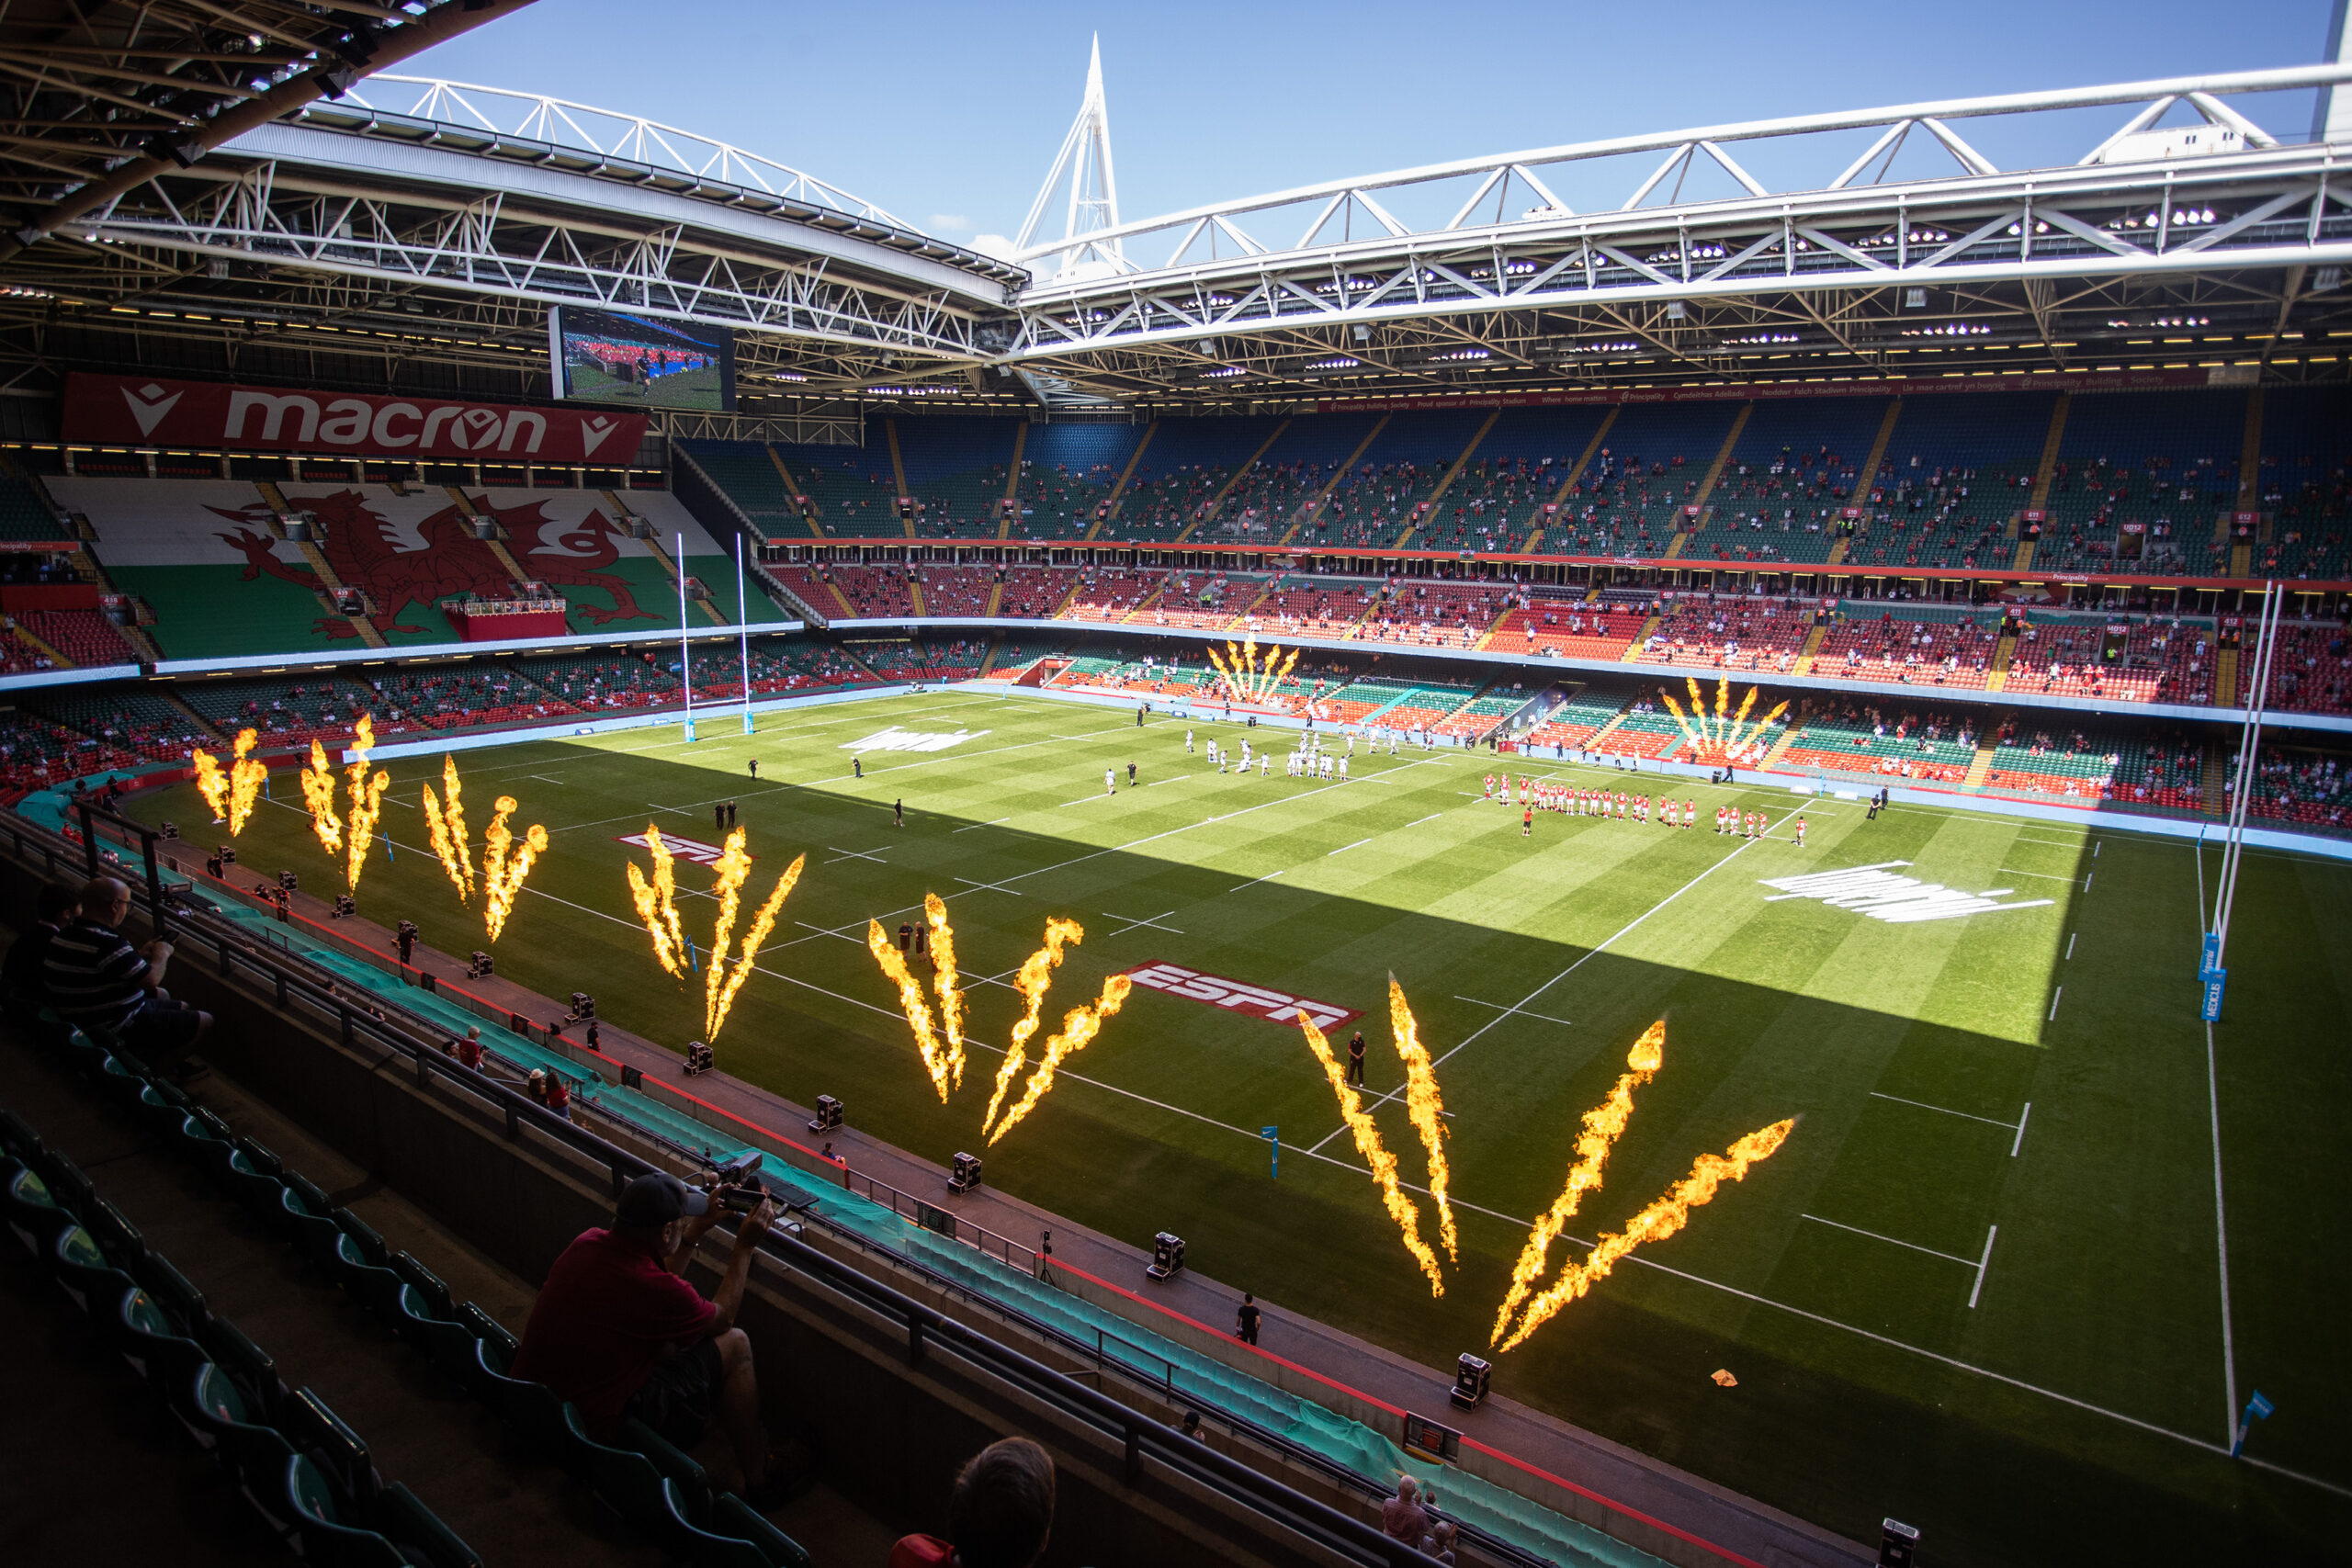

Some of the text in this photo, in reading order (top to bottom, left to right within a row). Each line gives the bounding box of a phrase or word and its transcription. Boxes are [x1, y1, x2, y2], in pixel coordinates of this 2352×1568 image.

[2032, 376, 2165, 389] Principality Building Society
[1849, 385, 1892, 395] Principality
[1630, 392, 1665, 401] Principality
[1470, 399, 1500, 407] Principality
[224, 389, 547, 454] macron
[1613, 558, 1640, 566] Principality
[2052, 573, 2089, 581] Principality
[1128, 964, 1349, 1029] ESPN
[2207, 983, 2222, 1017] MEDICUS
